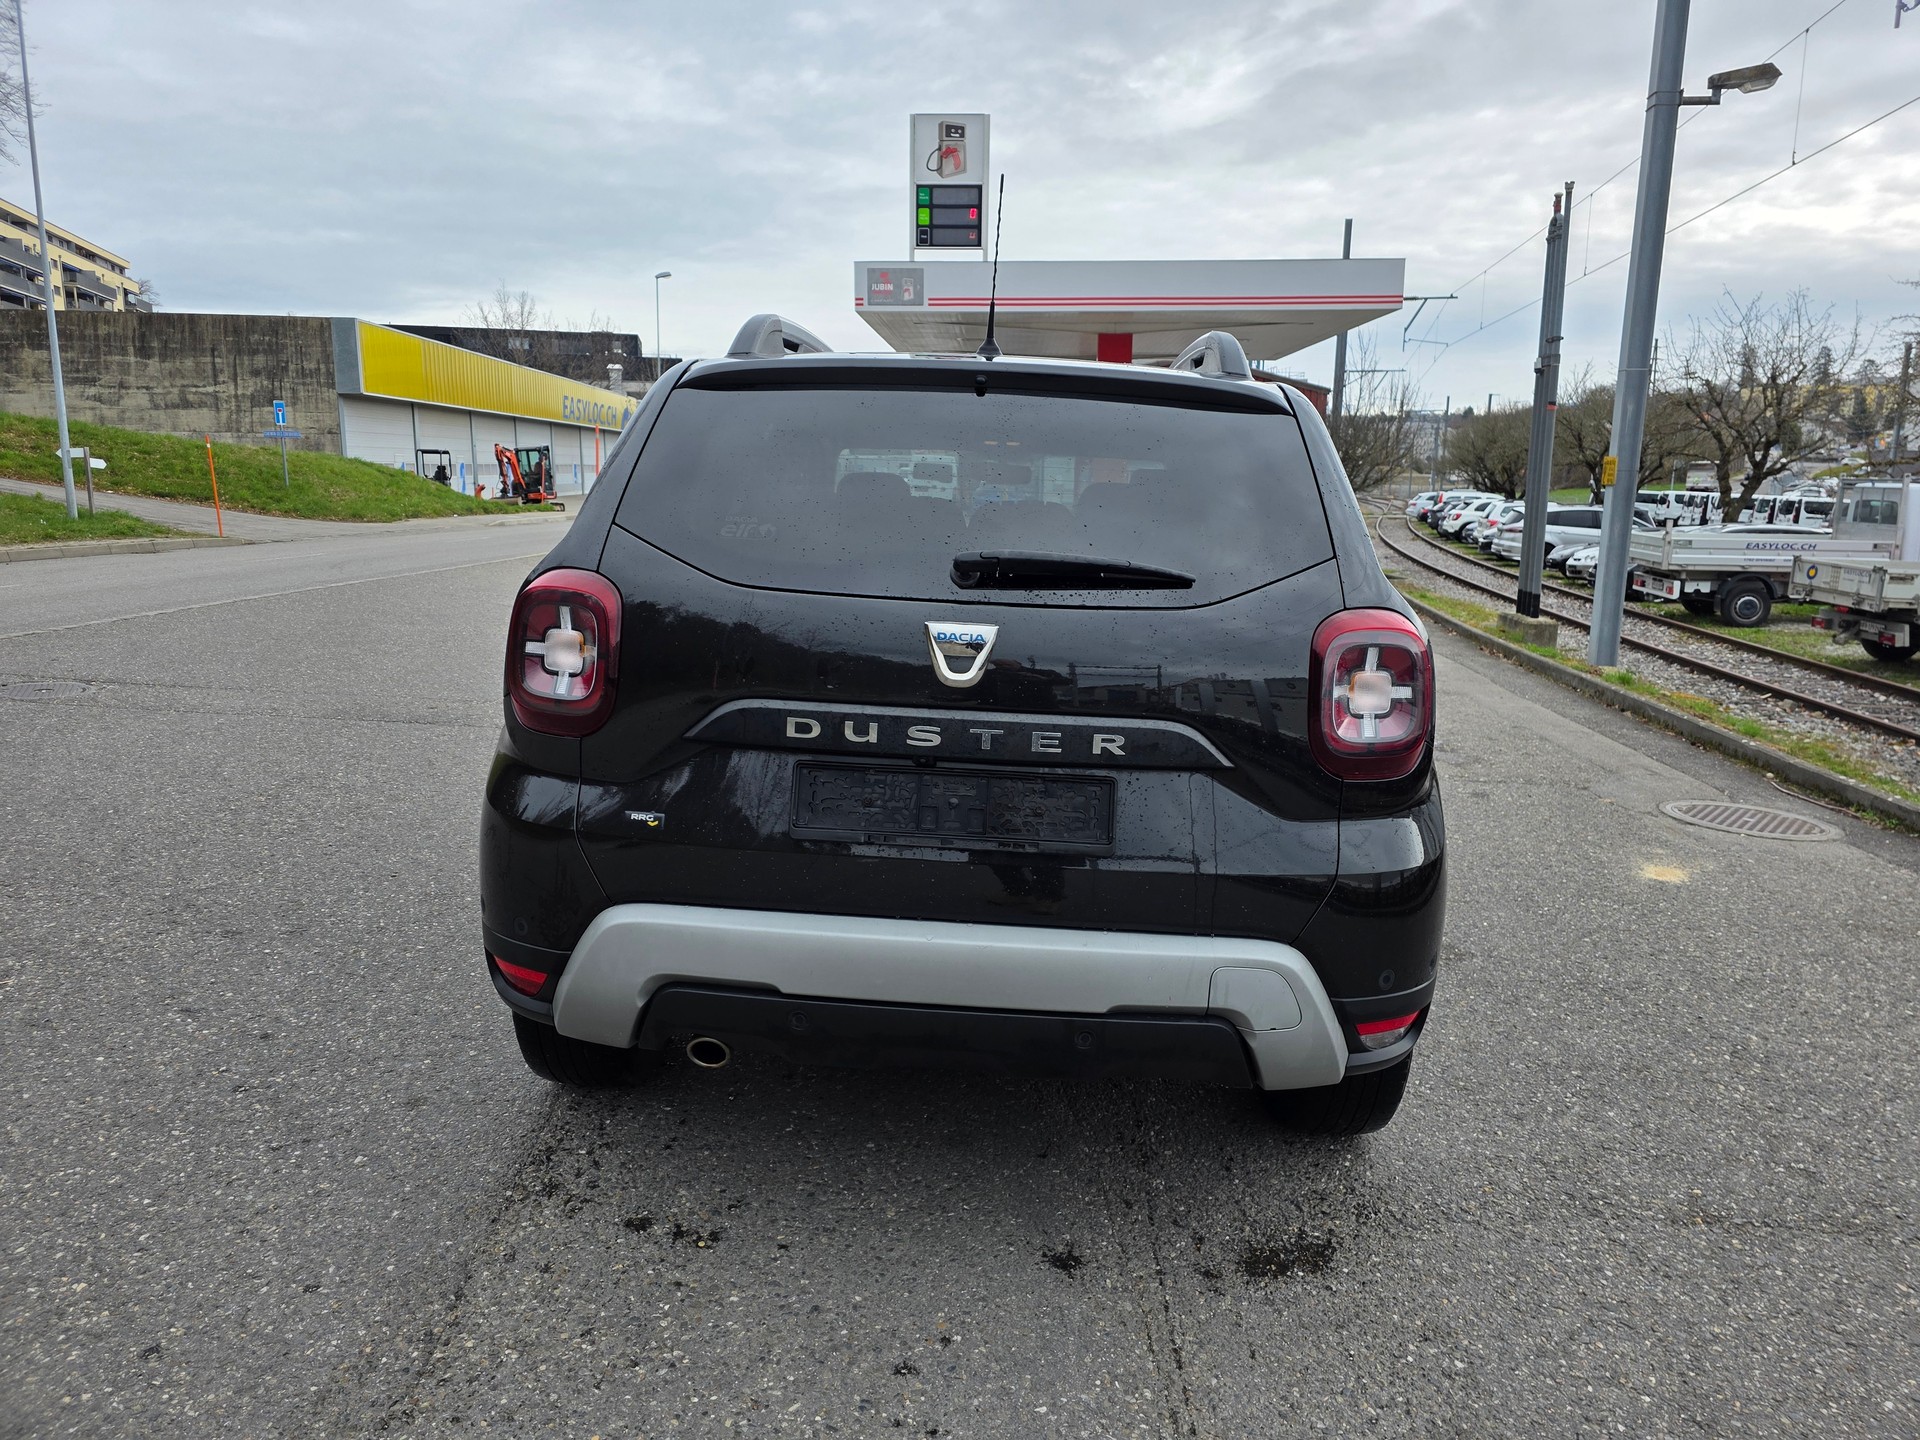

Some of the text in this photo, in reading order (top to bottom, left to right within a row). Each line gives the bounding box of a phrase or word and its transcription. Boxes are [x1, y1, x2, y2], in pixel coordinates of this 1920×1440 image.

[871, 283, 894, 291] JUBIN
[563, 395, 617, 426] EASYLOC.CH
[1745, 542, 1817, 551] EASYLOC.CH
[936, 632, 986, 643] DACIA
[786, 716, 1126, 756] DUSTER
[630, 813, 655, 822] RRG
